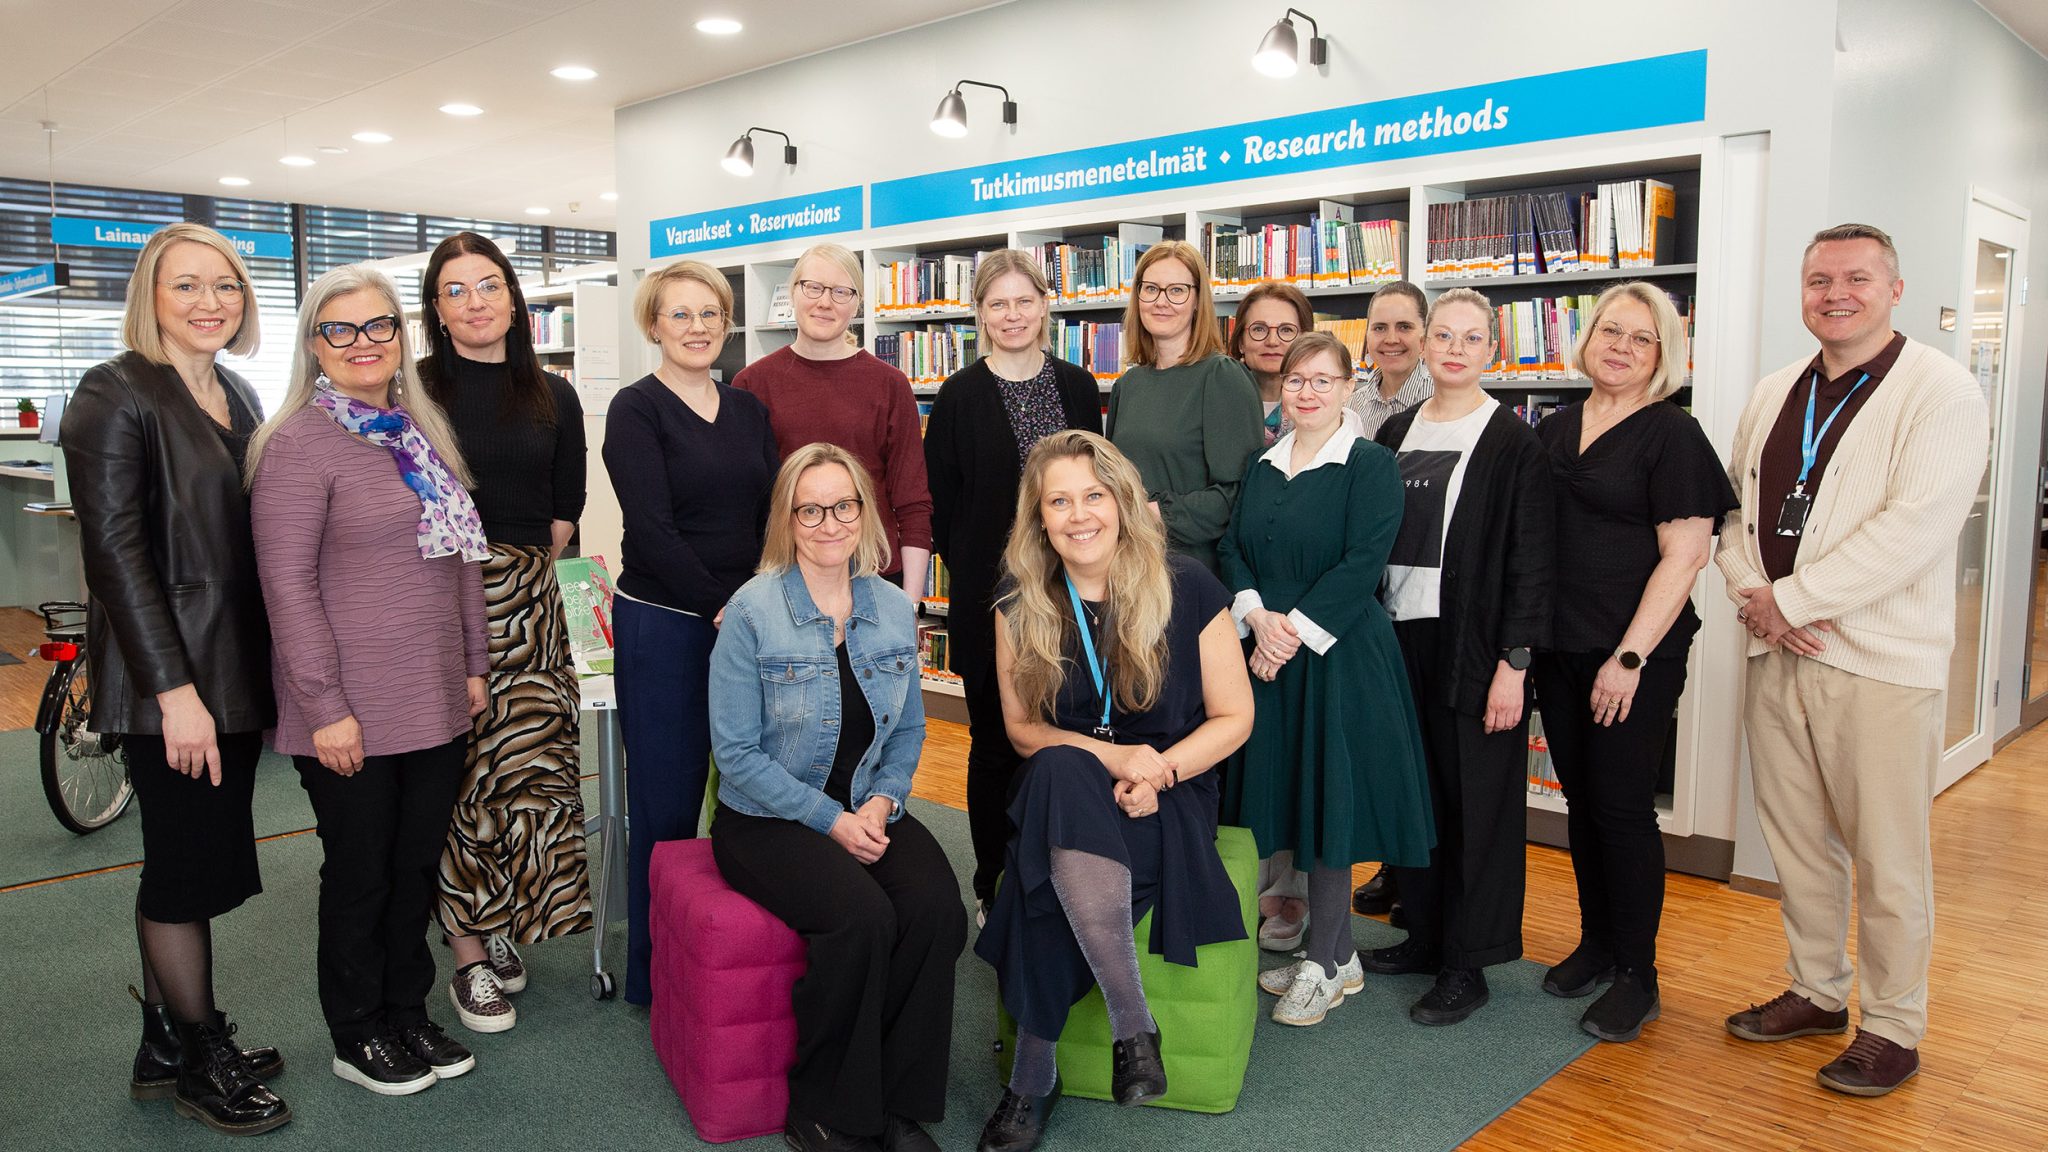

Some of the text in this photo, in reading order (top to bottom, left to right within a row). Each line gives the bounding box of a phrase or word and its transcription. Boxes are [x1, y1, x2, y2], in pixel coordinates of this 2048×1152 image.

[971, 98, 1509, 201] Tutkimusmenetelmät Research methods
[95, 226, 255, 255] Lainau ing
[666, 203, 841, 246] Varaukset Reservations
[1405, 479, 1429, 488] 984
